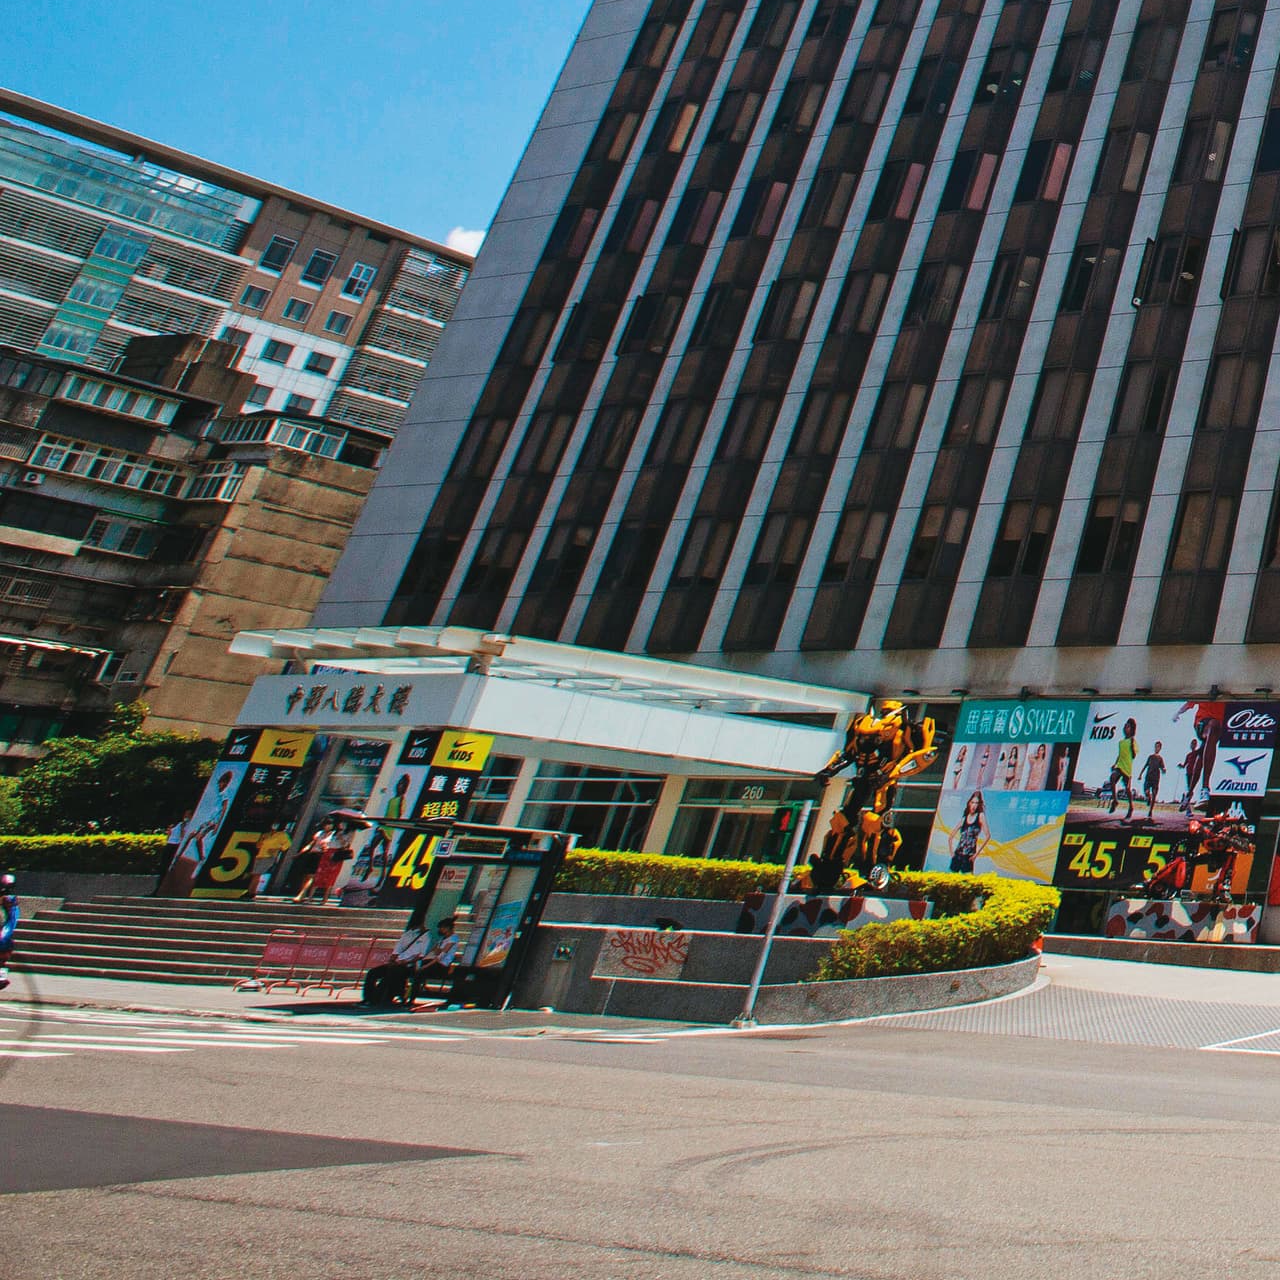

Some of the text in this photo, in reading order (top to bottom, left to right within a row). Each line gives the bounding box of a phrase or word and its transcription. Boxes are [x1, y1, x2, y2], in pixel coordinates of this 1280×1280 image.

[1025, 708, 1077, 736] SWEAR
[1227, 708, 1277, 729] Otto
[1089, 725, 1117, 741] KIDS
[228, 743, 246, 756] KIDS
[269, 747, 298, 759] KIDS
[408, 746, 427, 759] KIDS
[447, 749, 475, 762] KIDS
[251, 767, 292, 786] 鞋子
[428, 775, 473, 794] 童裝
[741, 785, 765, 801] 260
[421, 800, 460, 818] 超殺
[210, 831, 263, 883] 5
[1068, 840, 1118, 880] 4.5
